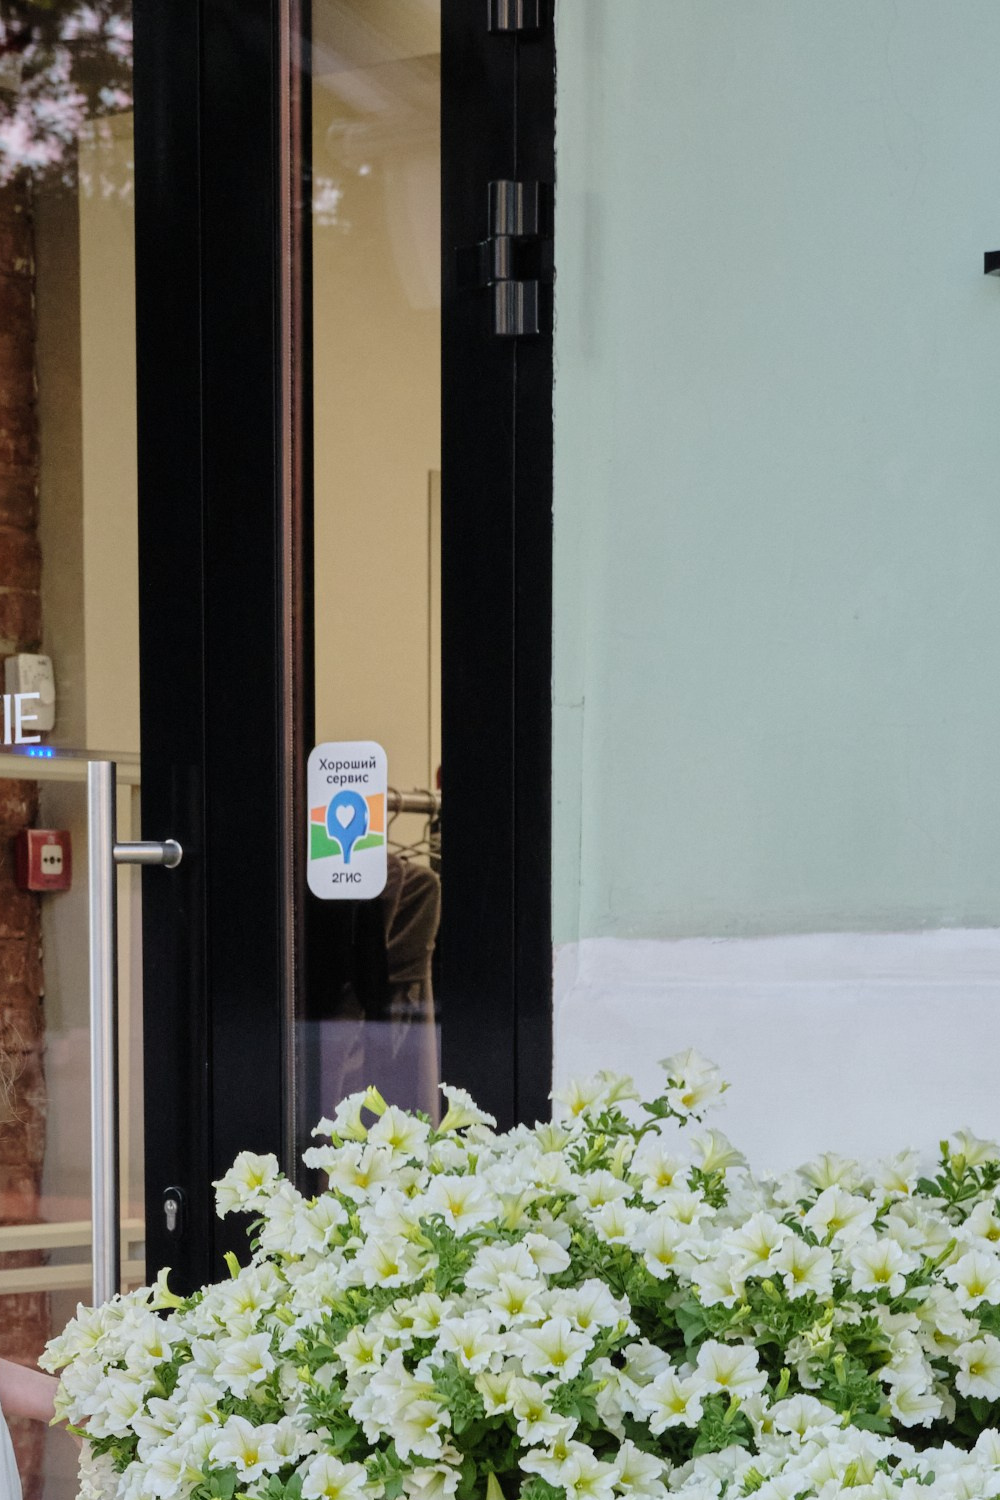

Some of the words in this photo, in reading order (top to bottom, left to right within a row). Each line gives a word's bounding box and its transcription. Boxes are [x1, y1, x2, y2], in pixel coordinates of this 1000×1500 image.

[319, 756, 376, 773] Хороший
[326, 774, 369, 786] сервис
[332, 872, 362, 883] 2ГИС
